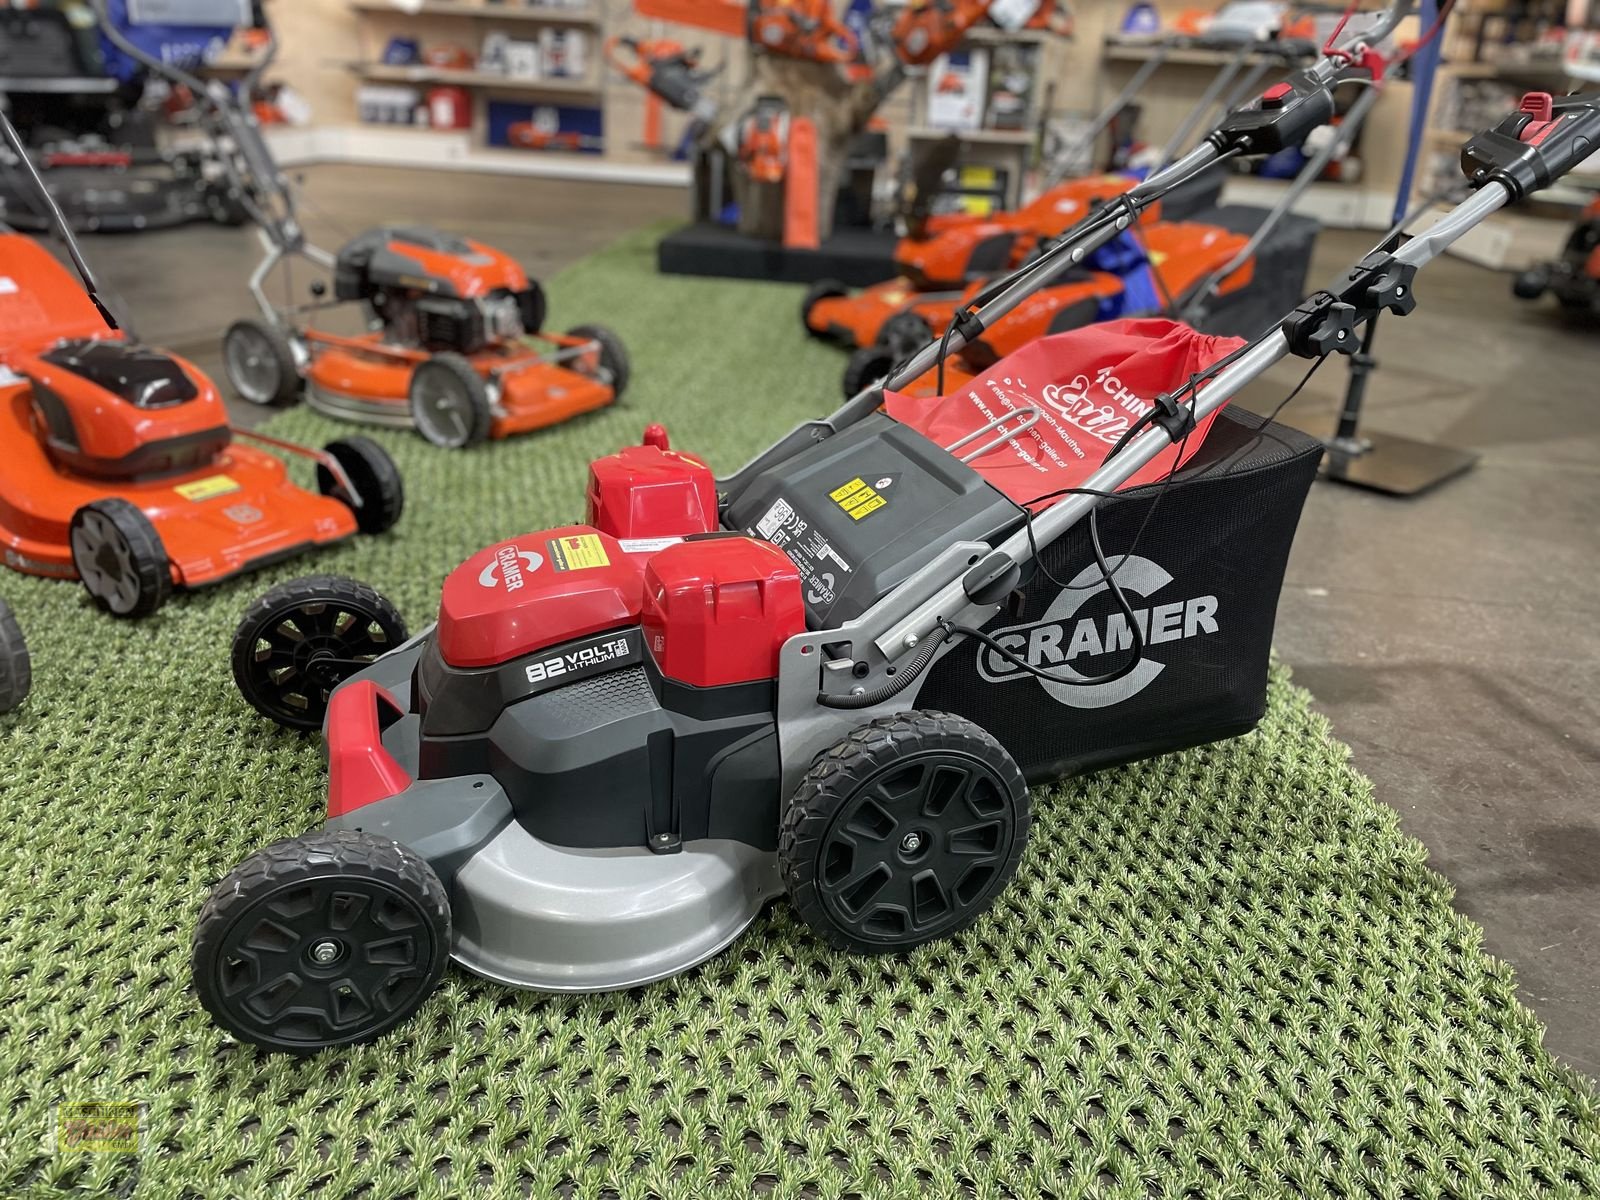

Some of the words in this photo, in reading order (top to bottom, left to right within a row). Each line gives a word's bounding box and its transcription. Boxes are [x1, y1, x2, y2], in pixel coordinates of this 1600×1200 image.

[498, 546, 524, 593] CRAMER
[809, 574, 834, 603] CRAMER
[989, 595, 1219, 673] CRAMER
[525, 658, 567, 683] 82
[565, 641, 616, 664] VOLT
[567, 652, 615, 672] LITHIUM
